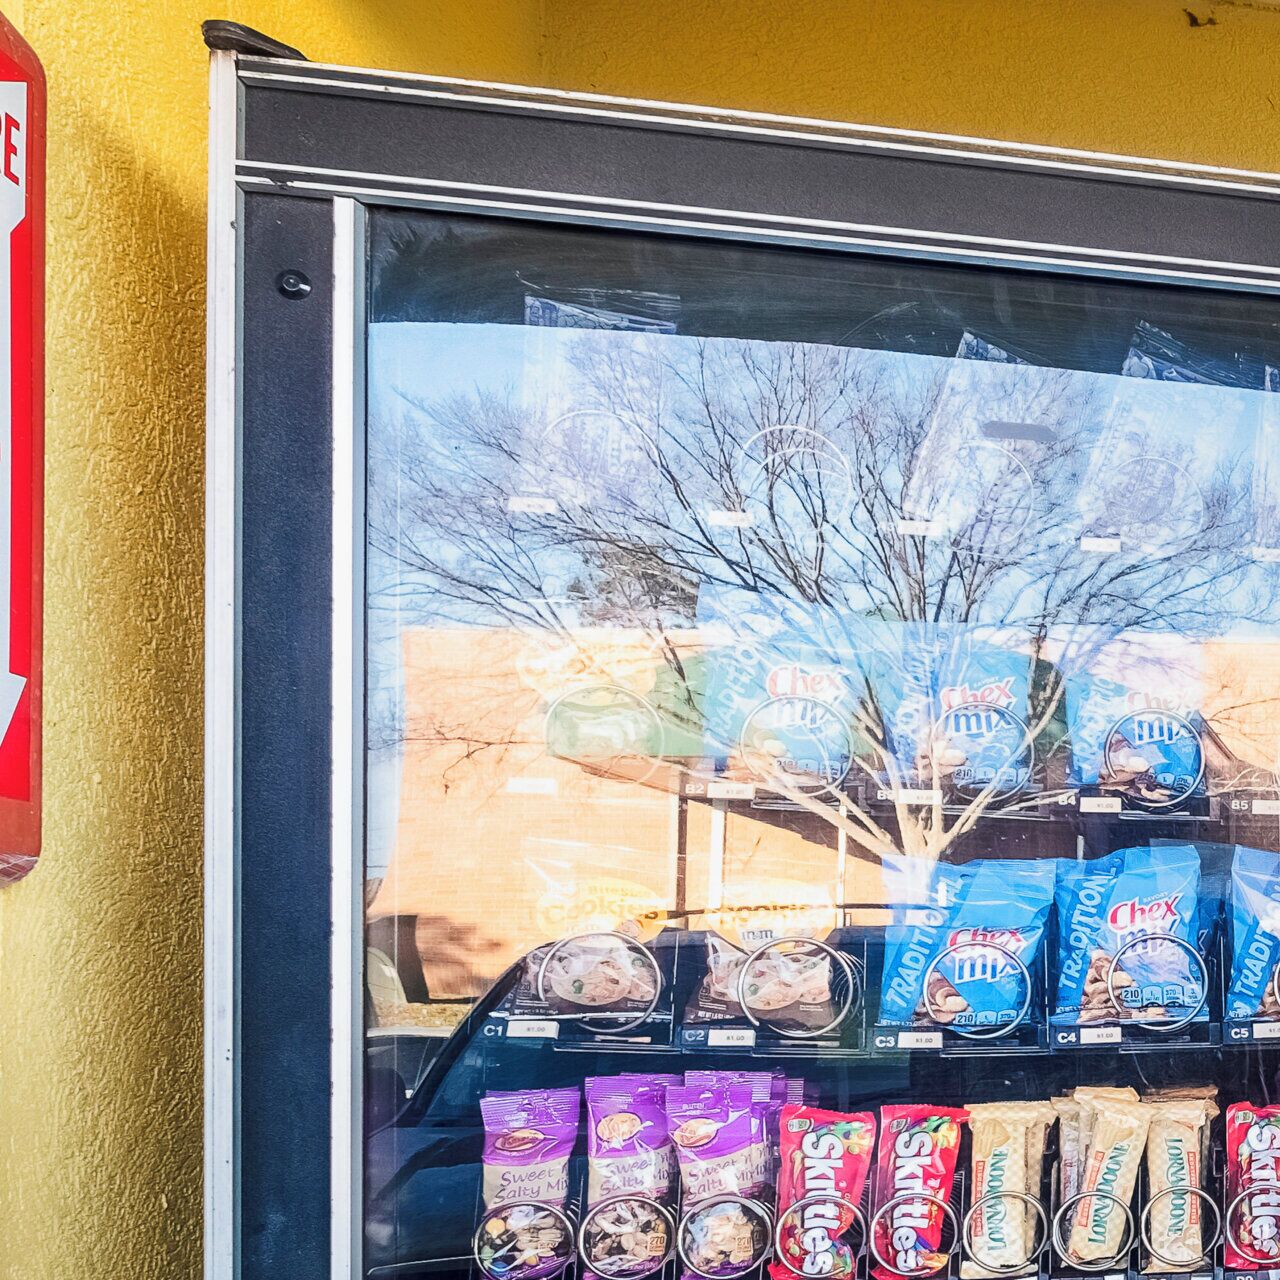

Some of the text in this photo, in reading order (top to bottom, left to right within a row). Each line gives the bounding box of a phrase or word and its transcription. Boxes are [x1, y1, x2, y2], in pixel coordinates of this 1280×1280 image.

[940, 677, 1016, 712] Chex
[1231, 800, 1249, 810] B5
[1109, 895, 1180, 931] Chex
[948, 926, 1024, 957] Chex
[1123, 988, 1140, 999] 210
[957, 1013, 974, 1024] 210
[483, 1025, 503, 1036] C1
[684, 1030, 705, 1041] C2
[1230, 1028, 1250, 1038] C5
[874, 1035, 896, 1048] C3
[1057, 1032, 1077, 1043] C4
[500, 1170, 552, 1188] Sweet
[495, 1183, 541, 1205] Salty
[802, 1132, 845, 1276] Skittles
[892, 1130, 933, 1272] Skittles
[649, 1235, 665, 1245] 270
